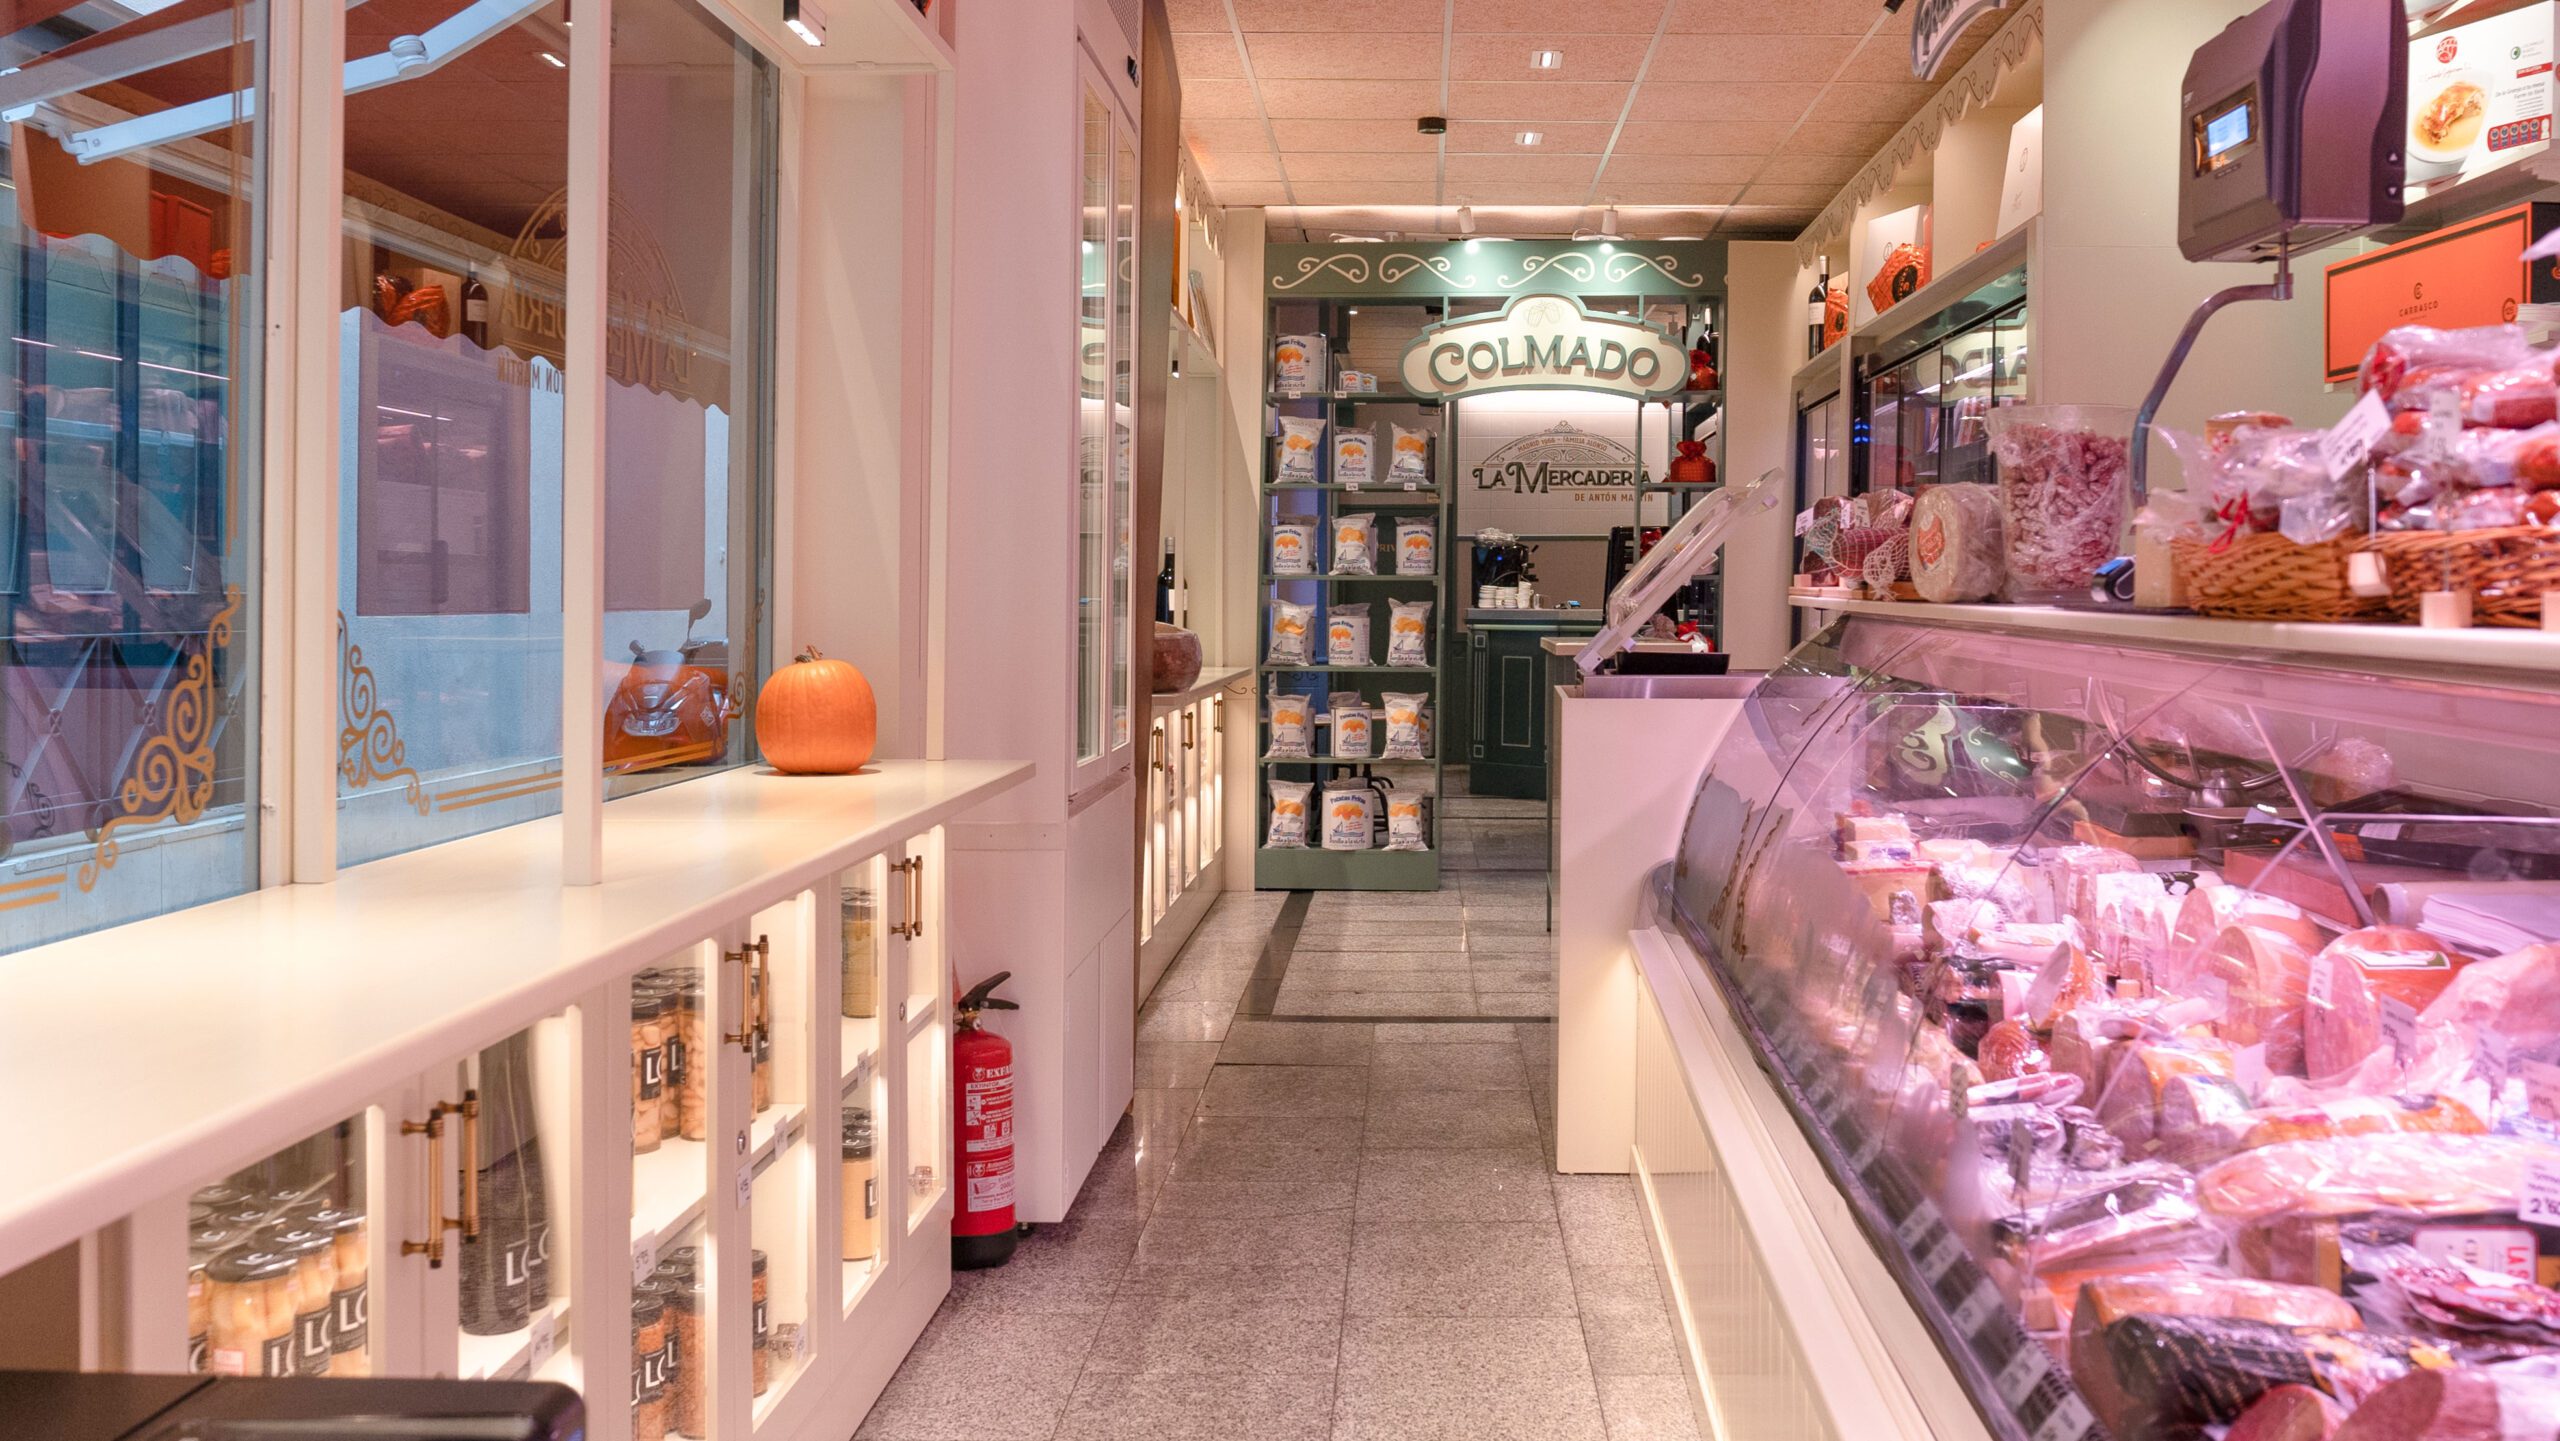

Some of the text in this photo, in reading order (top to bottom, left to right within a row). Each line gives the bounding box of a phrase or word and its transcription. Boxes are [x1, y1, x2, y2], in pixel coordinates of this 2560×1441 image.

[2399, 300, 2439, 318] CARRASCO
[1428, 335, 1660, 386] COLMADO
[1518, 440, 1540, 452] MADRID
[1562, 436, 1585, 444] FAMILIA
[1586, 440, 1608, 452] ALONSO
[1472, 461, 1652, 494] LA MERCADERA
[1575, 493, 1585, 502] DE
[1589, 492, 1616, 502] ANTÓN
[1330, 794, 1366, 804] Patatas Fritas
